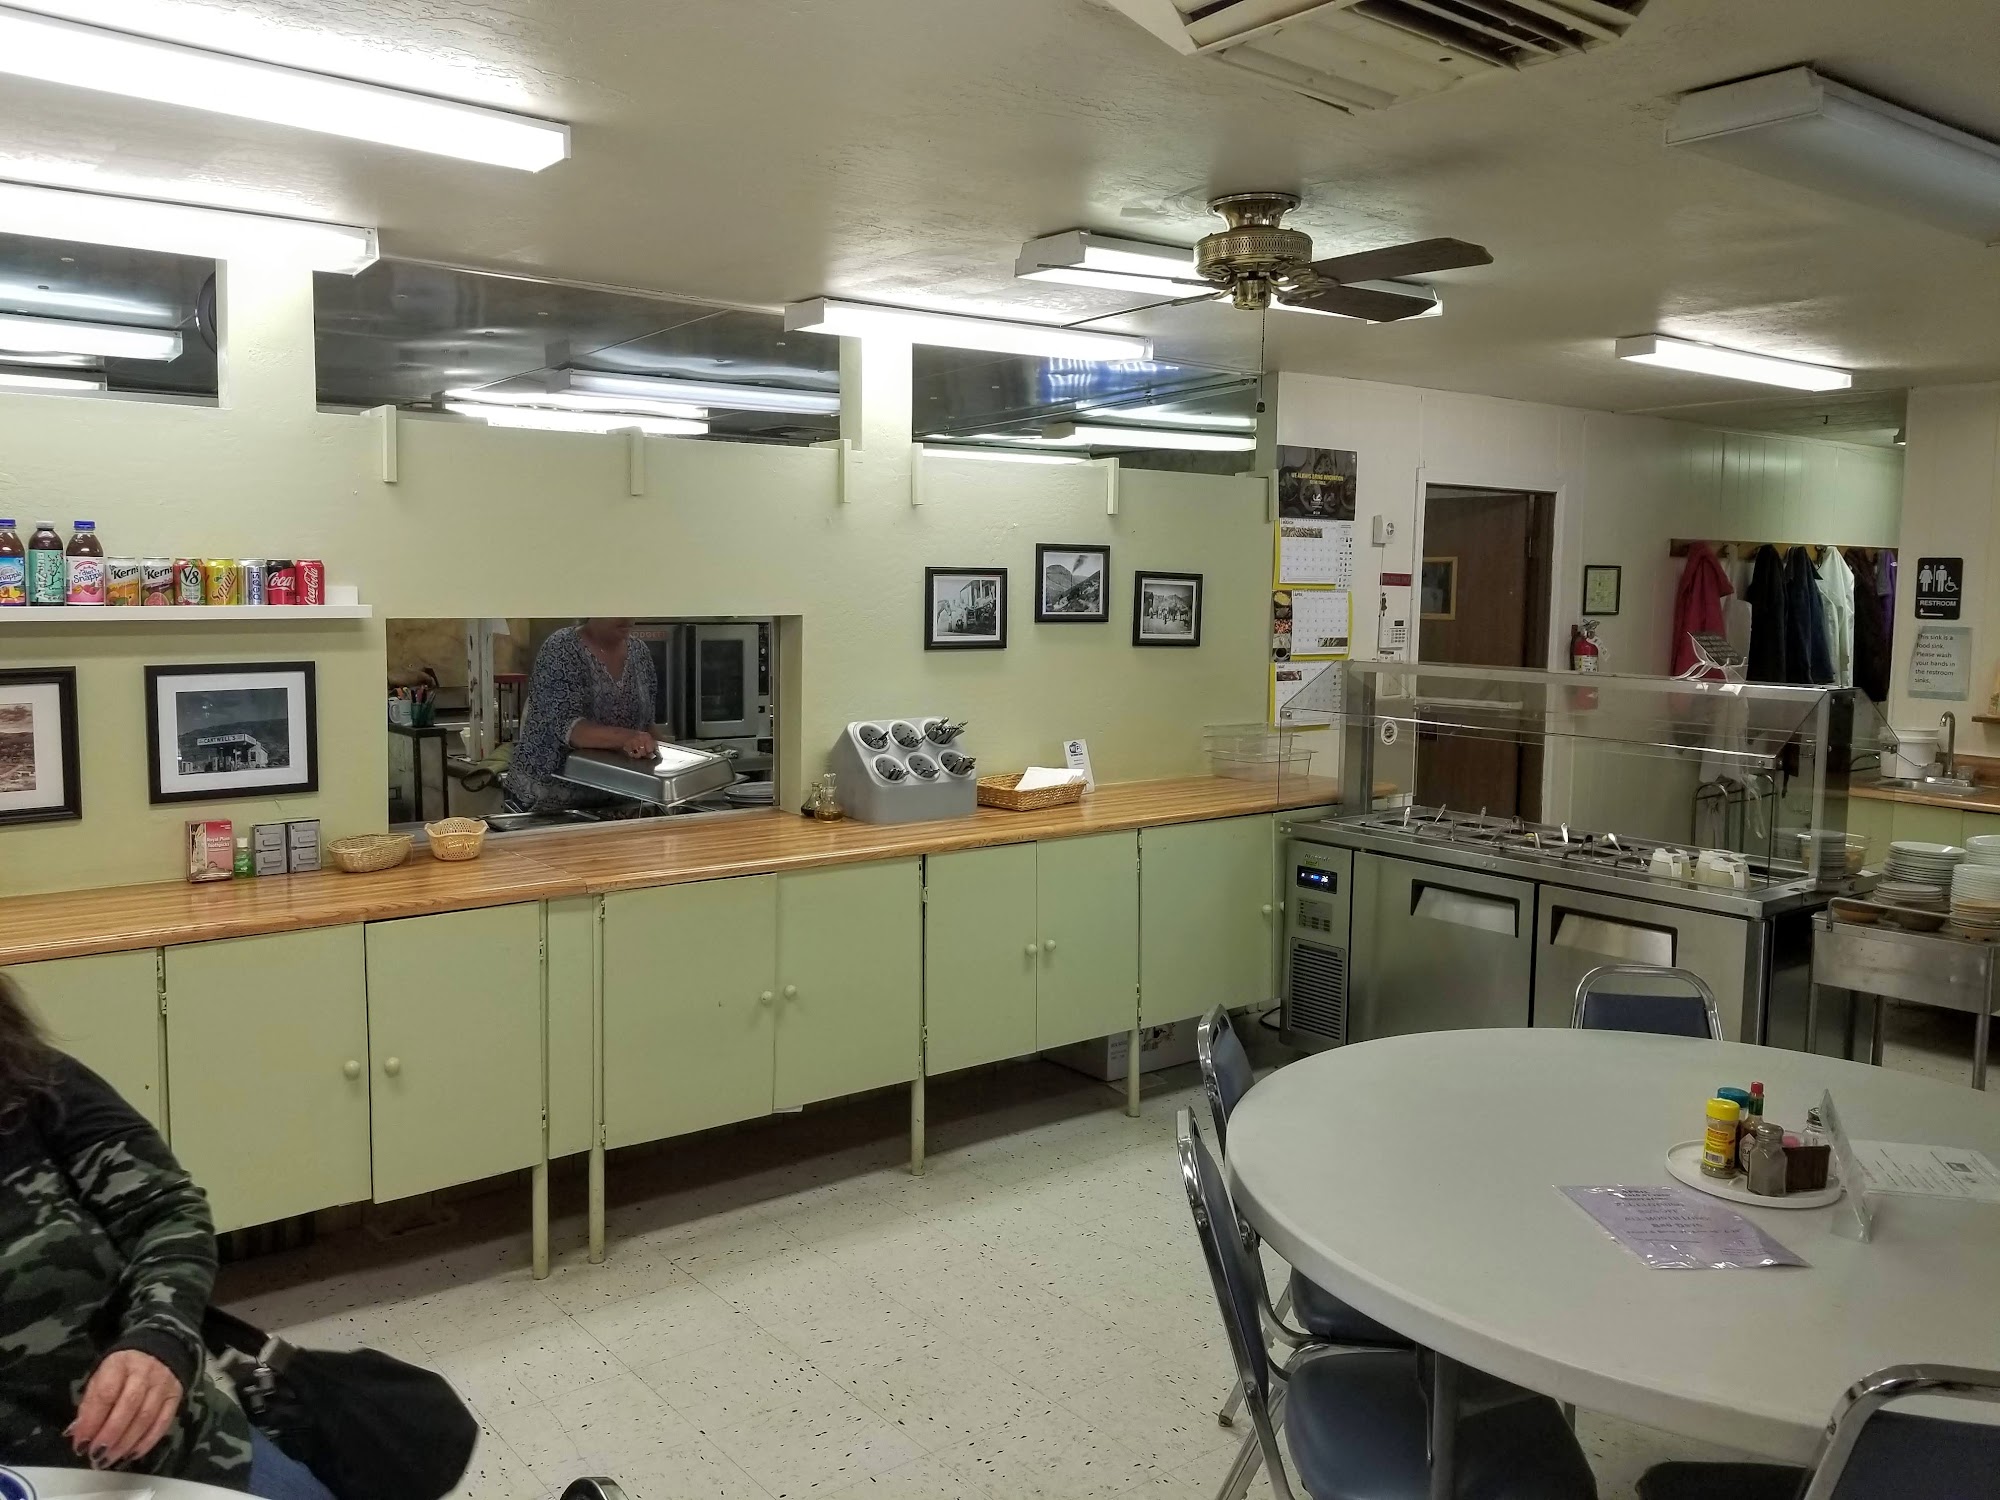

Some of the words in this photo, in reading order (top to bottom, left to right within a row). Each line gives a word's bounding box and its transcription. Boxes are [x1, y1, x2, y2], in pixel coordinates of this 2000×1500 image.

[181, 565, 199, 584] V8
[250, 570, 262, 601] pepsi
[303, 565, 319, 605] Coca-Cola
[1919, 599, 1957, 607] RESTROOM
[1915, 660, 1929, 668] your
